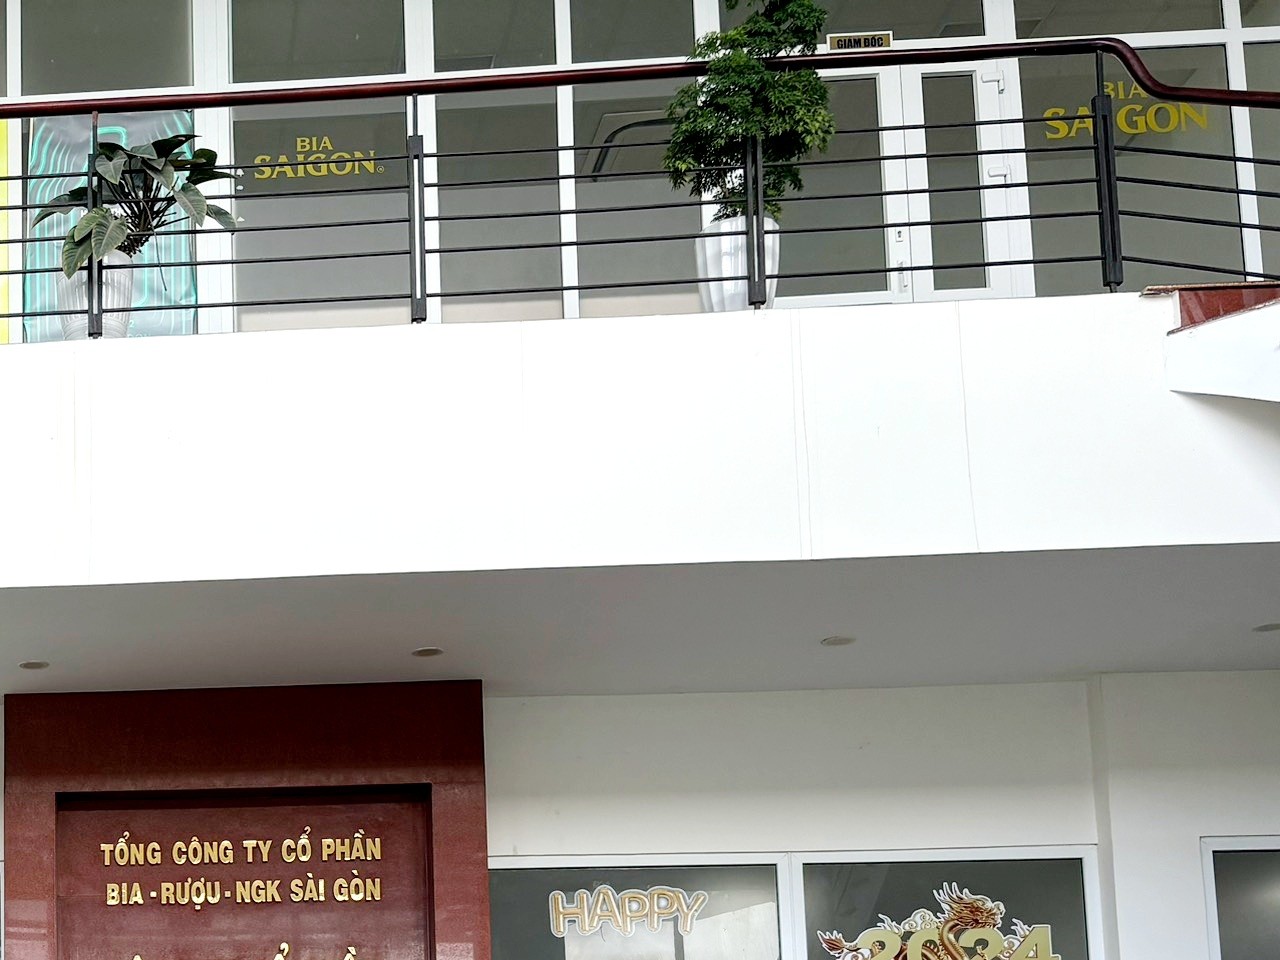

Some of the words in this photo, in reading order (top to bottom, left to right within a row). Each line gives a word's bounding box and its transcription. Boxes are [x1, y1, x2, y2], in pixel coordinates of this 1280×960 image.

[1103, 81, 1148, 99] BIA
[1043, 103, 1208, 139] SAGON
[296, 136, 333, 152] BIA
[254, 150, 375, 179] SAIGON
[100, 831, 162, 866] TỔNG
[172, 837, 234, 865] CÔNG
[243, 840, 272, 863] TY
[282, 826, 312, 862] CỔ
[322, 829, 382, 861] PHẦN
[106, 882, 144, 906] BIA
[161, 877, 221, 910] RƯỢU
[236, 879, 282, 903] NGK
[290, 872, 326, 902] SÀI
[333, 870, 382, 901] GÒN
[550, 886, 707, 936] HAPPY
